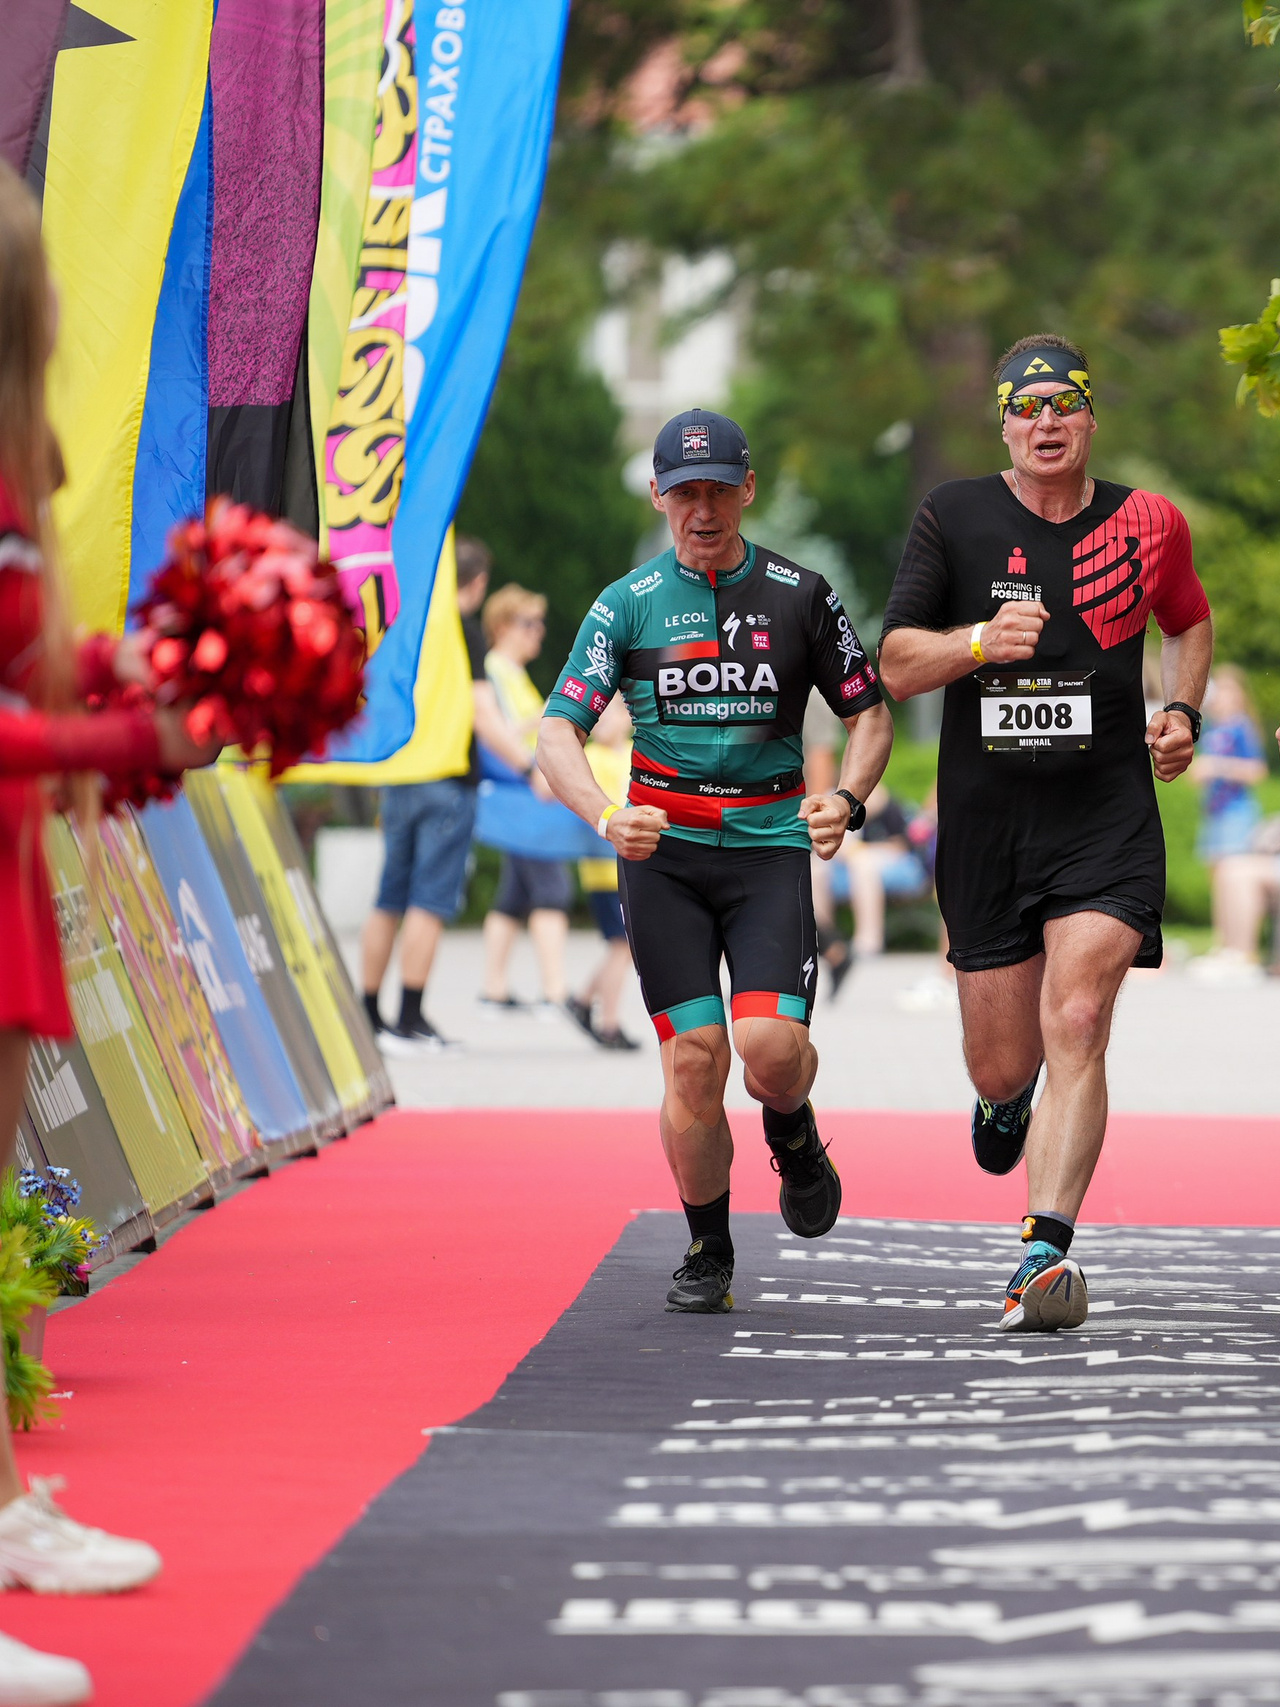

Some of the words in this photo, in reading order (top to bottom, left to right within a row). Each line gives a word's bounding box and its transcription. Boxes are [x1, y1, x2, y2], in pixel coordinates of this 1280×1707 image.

[419, 0, 467, 183] СТРАХОВ
[680, 567, 700, 581] BORA
[766, 561, 800, 580] BORA
[629, 570, 662, 592] BORA
[634, 578, 664, 597] hansgrohe
[991, 581, 1032, 592] ANYTHING
[1034, 585, 1042, 593] IS
[991, 590, 1042, 601] POSSIBLE
[665, 615, 680, 628] LE
[682, 612, 709, 624] COL
[658, 662, 779, 697] BORA
[665, 696, 774, 720] hansgrohe
[998, 703, 1073, 730] 2008
[1018, 738, 1052, 747] MIKHAIL
[639, 774, 670, 788] TopCycler
[699, 783, 742, 795] TopCycler
[730, 1347, 1023, 1359] IRON
